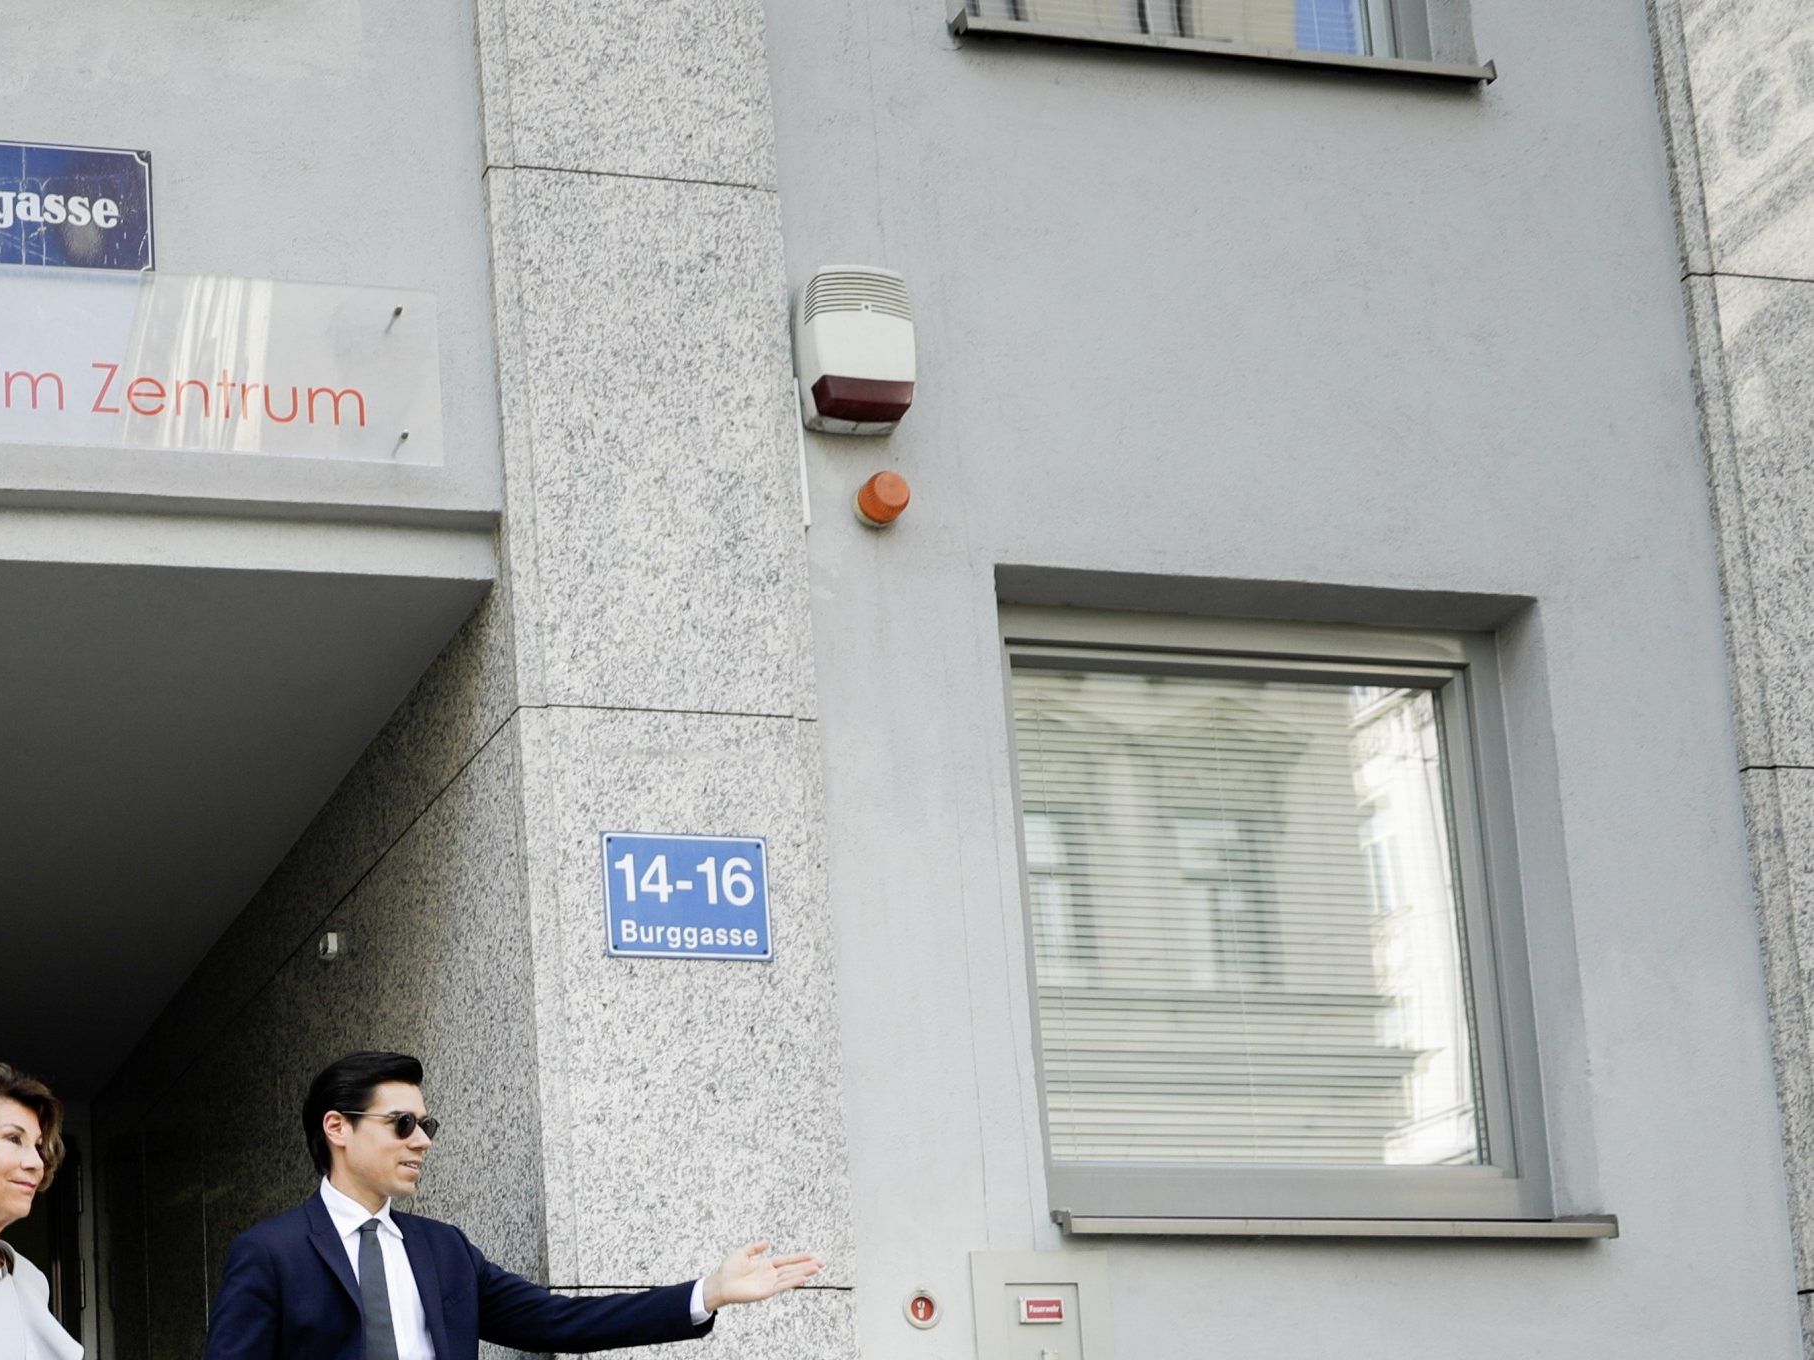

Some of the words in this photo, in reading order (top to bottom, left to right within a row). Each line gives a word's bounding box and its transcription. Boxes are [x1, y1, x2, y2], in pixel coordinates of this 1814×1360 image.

[91, 363, 366, 427] Zentrum
[614, 853, 755, 906] 14-16
[620, 919, 758, 948] Burggasse
